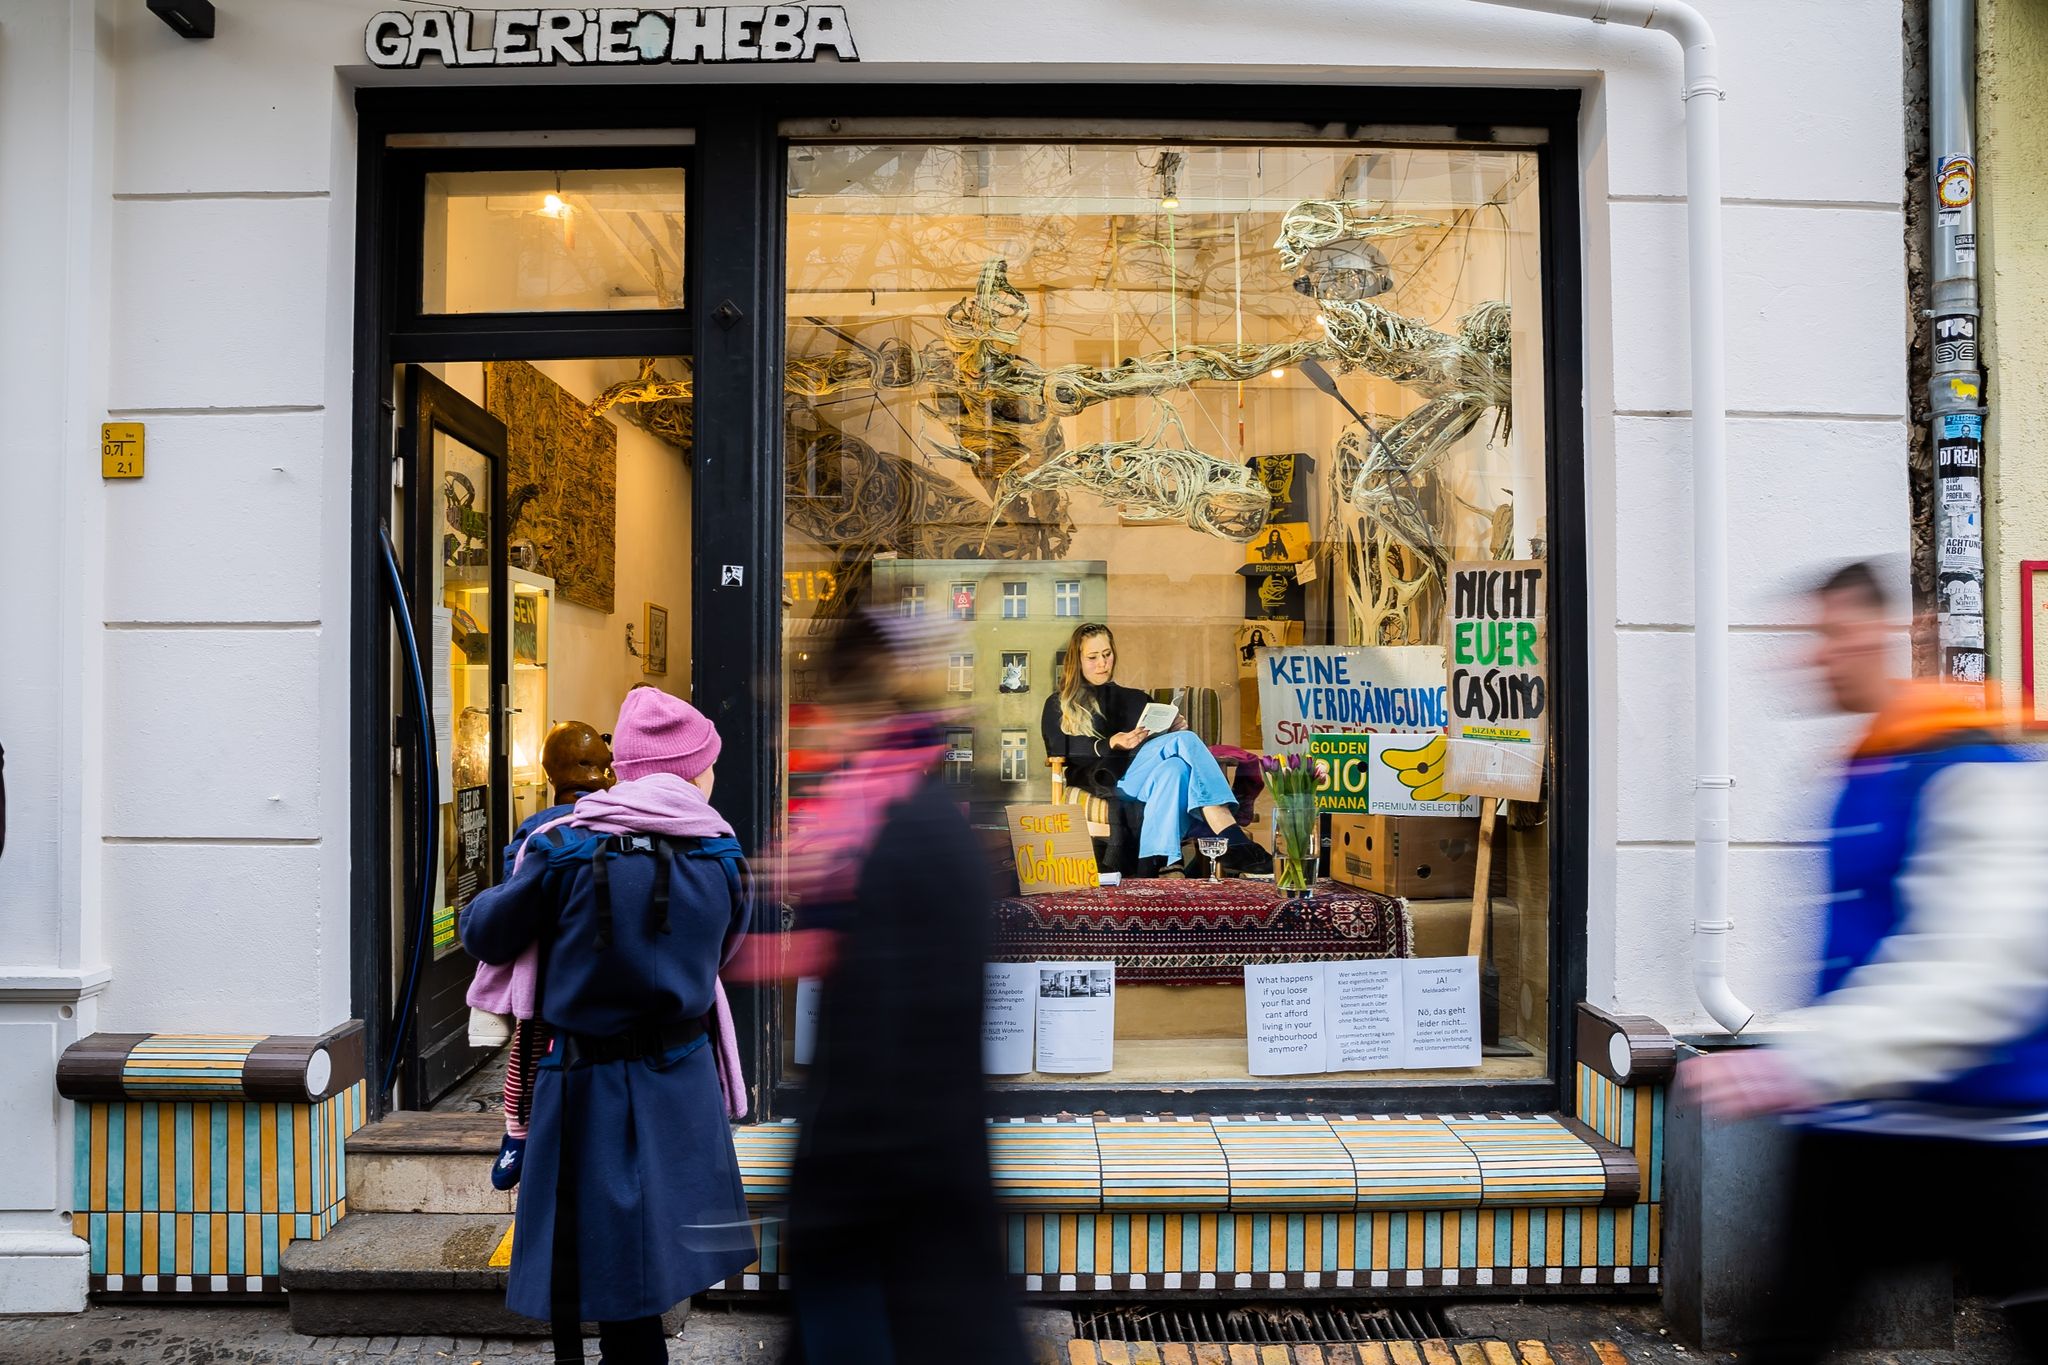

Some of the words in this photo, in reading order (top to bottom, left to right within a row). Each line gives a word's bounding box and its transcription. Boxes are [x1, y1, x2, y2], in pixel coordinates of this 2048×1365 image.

[670, 5, 860, 65] HEBA
[1939, 451, 1951, 466] DJ
[1255, 564, 1295, 573] FUKUSHIMA
[1454, 568, 1542, 620] NICHT
[1455, 621, 1539, 667] EUER
[1269, 655, 1350, 686] KEINE
[1452, 668, 1545, 723] CASINO
[1295, 681, 1448, 728] VERDRÄNGUNG
[1275, 720, 1334, 746] STA
[1472, 727, 1497, 735] BIZIM
[1499, 729, 1521, 737] KIEZ
[1310, 741, 1367, 754] GOLDEN
[1372, 801, 1417, 812] PREMIUM
[1419, 802, 1473, 813] SELECTION
[1020, 813, 1071, 833] SUCHE
[1017, 839, 1100, 888] Wohnung
[1256, 976, 1279, 984] What
[1280, 975, 1314, 984] happens
[1436, 976, 1448, 985] JA!
[1263, 988, 1269, 996] if
[1270, 989, 1285, 997] you
[1286, 987, 1308, 995] loose
[1261, 1001, 1280, 1009] your
[1281, 998, 1295, 1007] flat
[1296, 997, 1311, 1006] and
[1265, 1012, 1283, 1020] cant
[1284, 1009, 1309, 1018] afford
[1432, 1007, 1447, 1016] das
[1448, 1006, 1466, 1017] geht
[1262, 1023, 1283, 1032] living
[1294, 1021, 1312, 1030] your
[1417, 1019, 1440, 1028] leider
[1257, 1032, 1318, 1043] neighbourhood
[1268, 1044, 1308, 1054] anymore?
